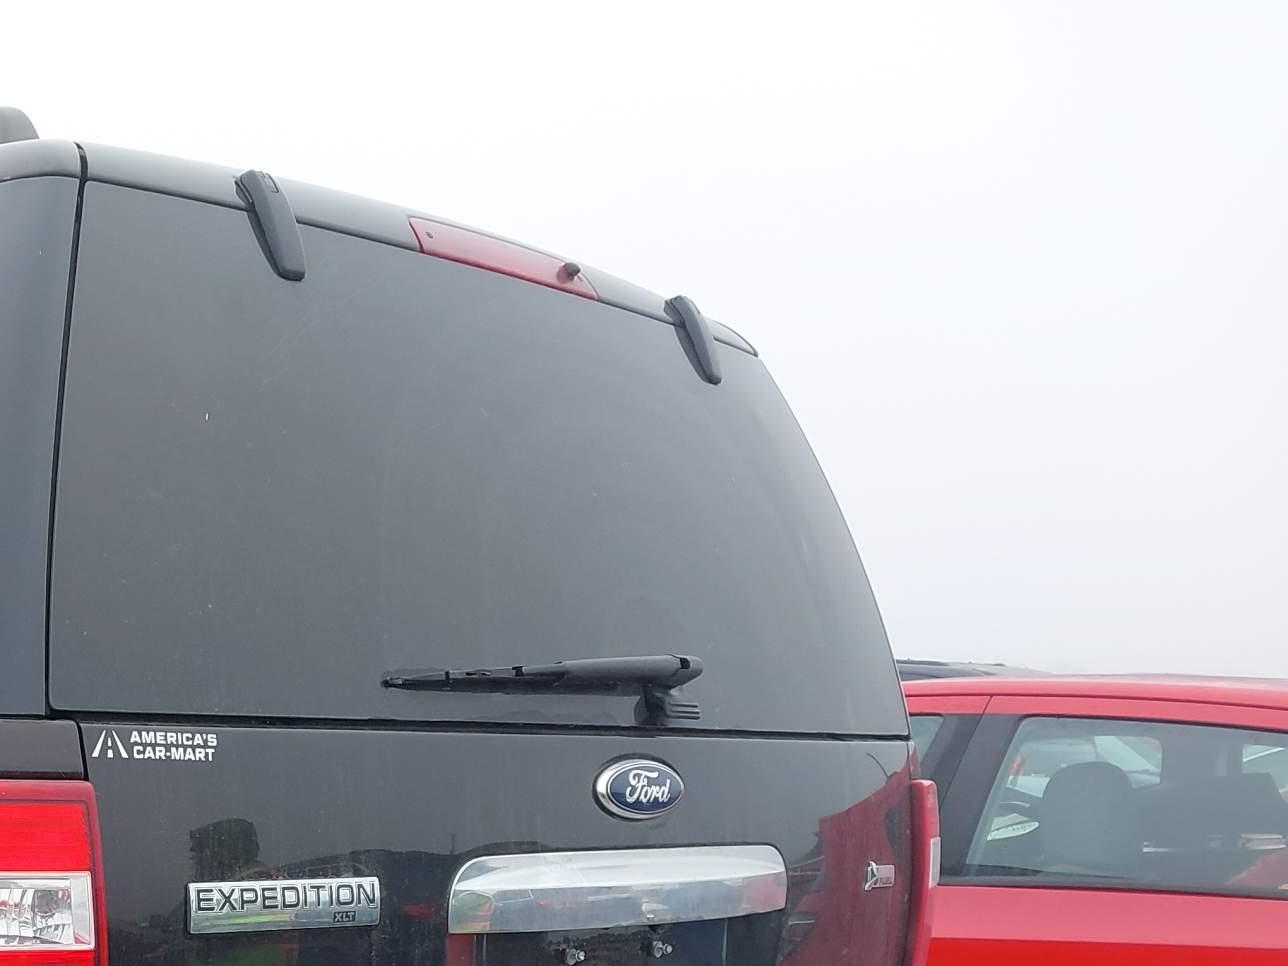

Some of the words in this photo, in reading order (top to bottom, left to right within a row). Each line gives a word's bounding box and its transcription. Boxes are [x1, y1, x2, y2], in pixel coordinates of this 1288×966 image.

[129, 730, 218, 747] AMERICA'S
[133, 746, 216, 762] CAR-MART
[625, 769, 671, 803] Ford
[196, 881, 377, 913] EXPEDITION
[333, 911, 355, 923] XLT
